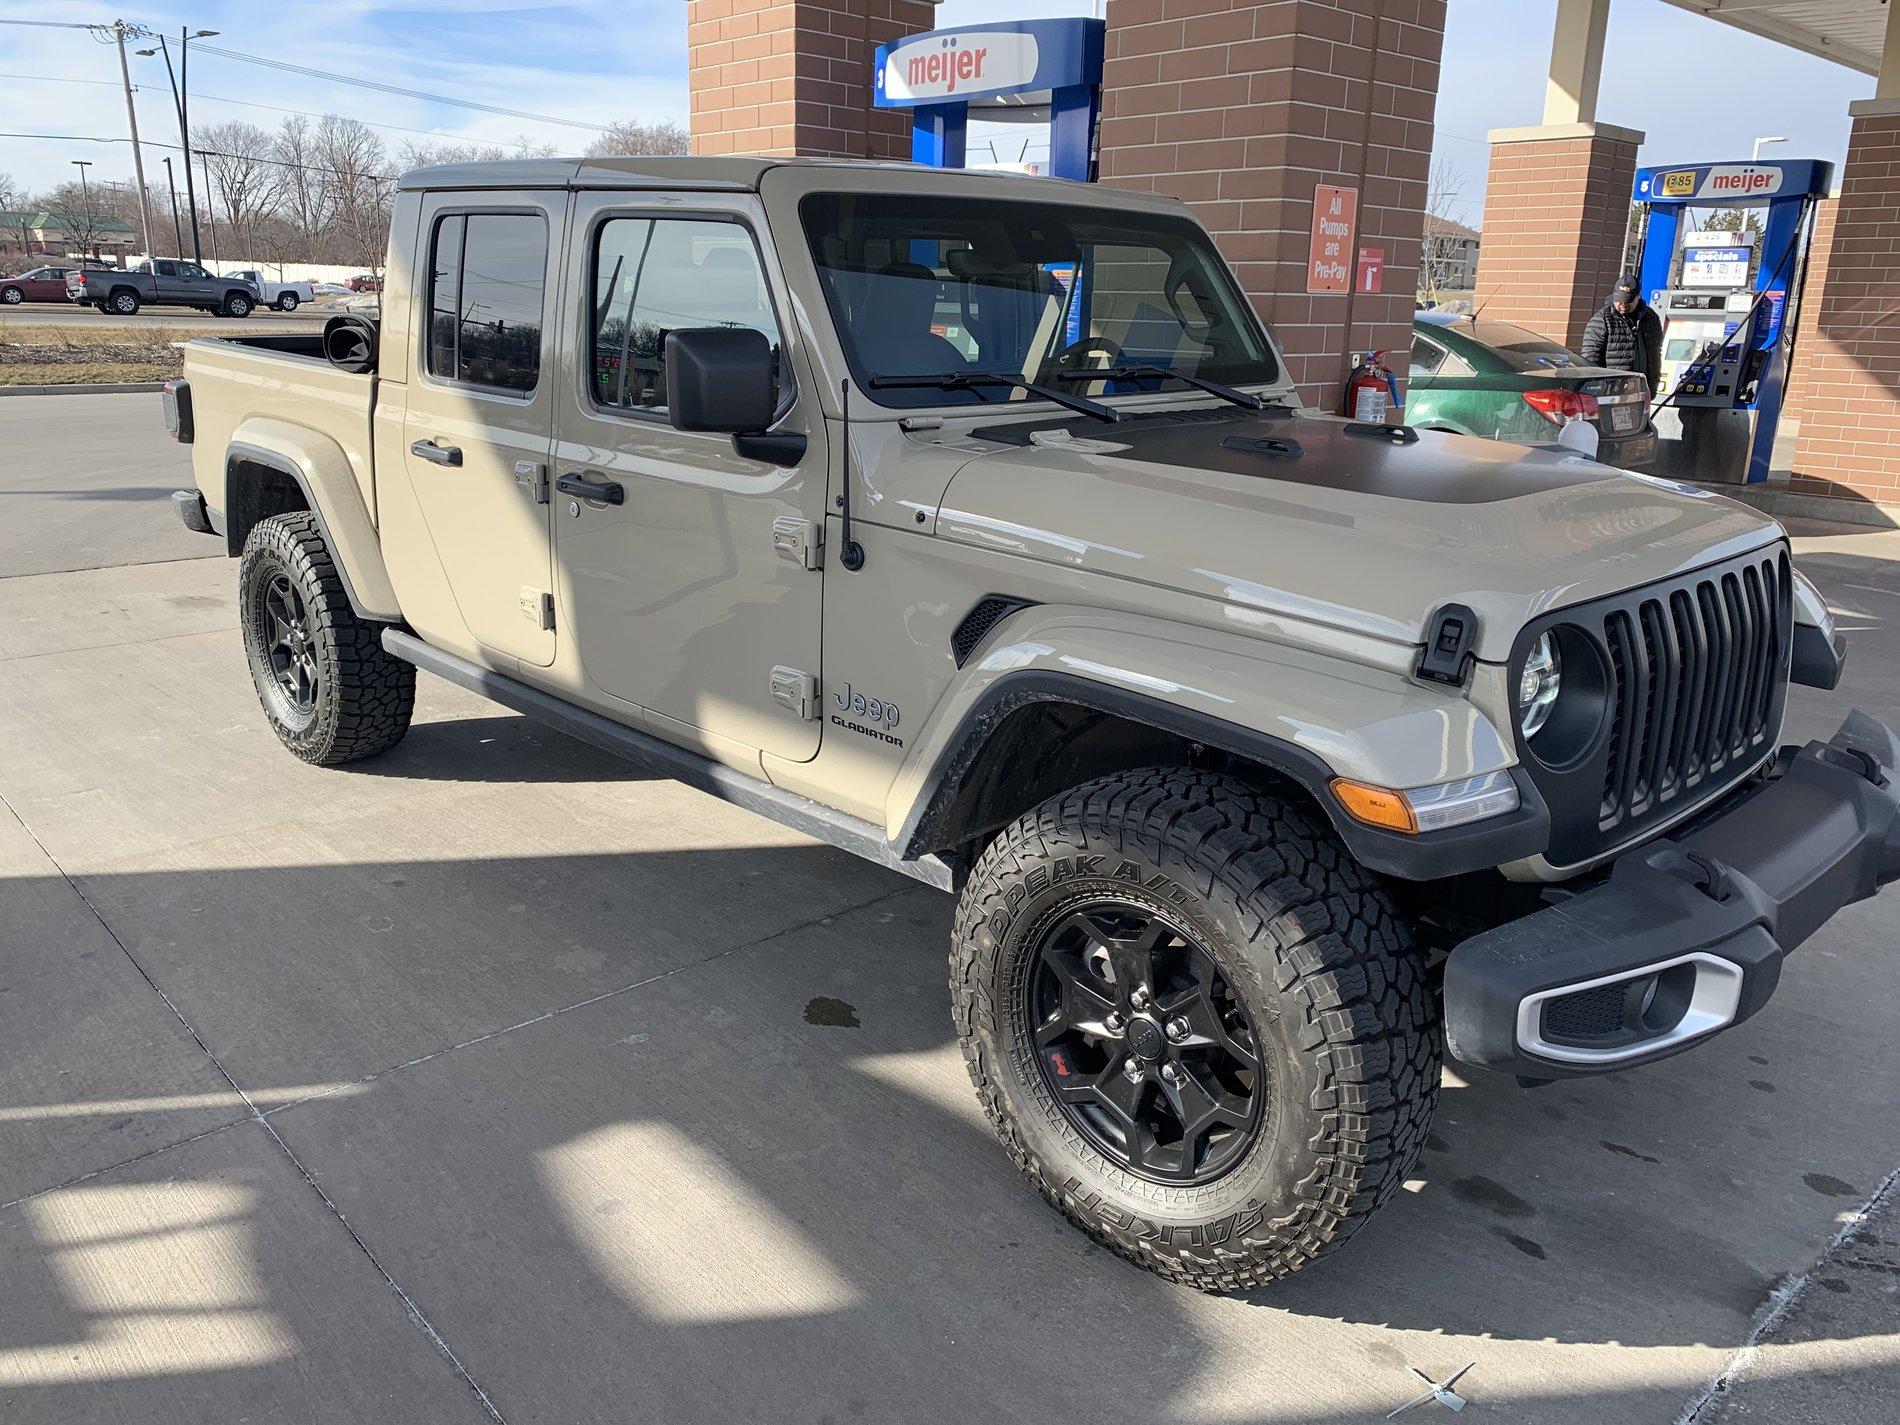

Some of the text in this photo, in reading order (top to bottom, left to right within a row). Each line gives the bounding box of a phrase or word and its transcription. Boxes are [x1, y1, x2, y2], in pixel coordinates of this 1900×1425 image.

[908, 37, 986, 92] meijer
[1640, 181, 1649, 192] 5
[1712, 169, 1774, 193] meijer
[1329, 197, 1342, 215] All
[1319, 217, 1348, 239] Pumps
[1325, 242, 1340, 256] are
[1315, 261, 1346, 283] Pre-Pay
[833, 682, 899, 731] Jeep
[831, 715, 904, 749] GLADIATOR
[977, 854, 1106, 1031] WILDPEAK
[1062, 1176, 1267, 1248] FALKEN
